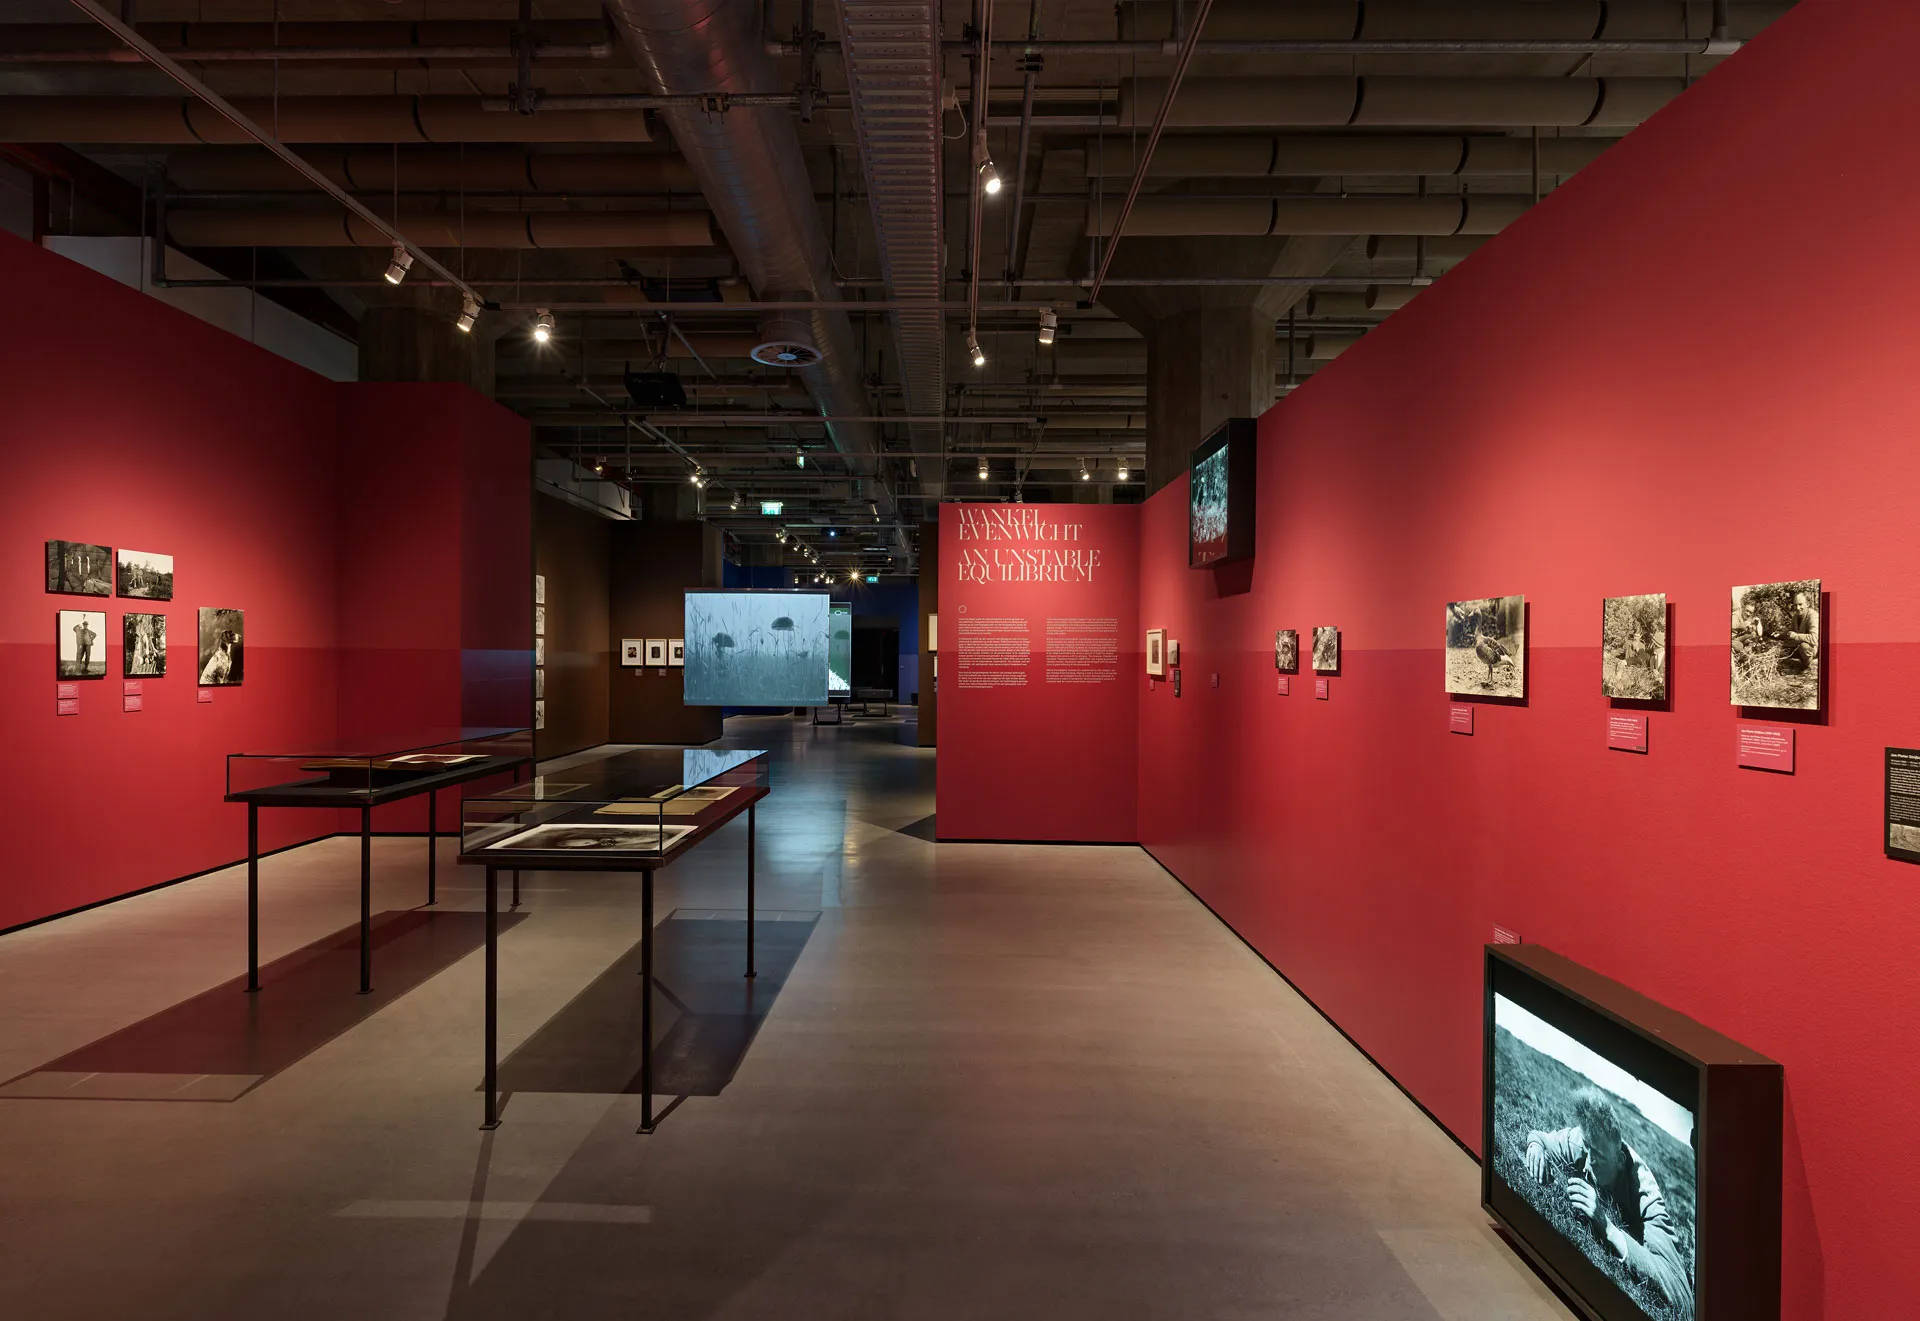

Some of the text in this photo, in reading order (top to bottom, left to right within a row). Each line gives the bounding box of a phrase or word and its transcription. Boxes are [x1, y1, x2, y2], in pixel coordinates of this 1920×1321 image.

[958, 508, 1046, 526] WANKEL
[958, 523, 1083, 541] EVENWICHT
[958, 549, 1101, 567] AN UNSTABLE
[958, 564, 1093, 584] EQUILIBRIUM
